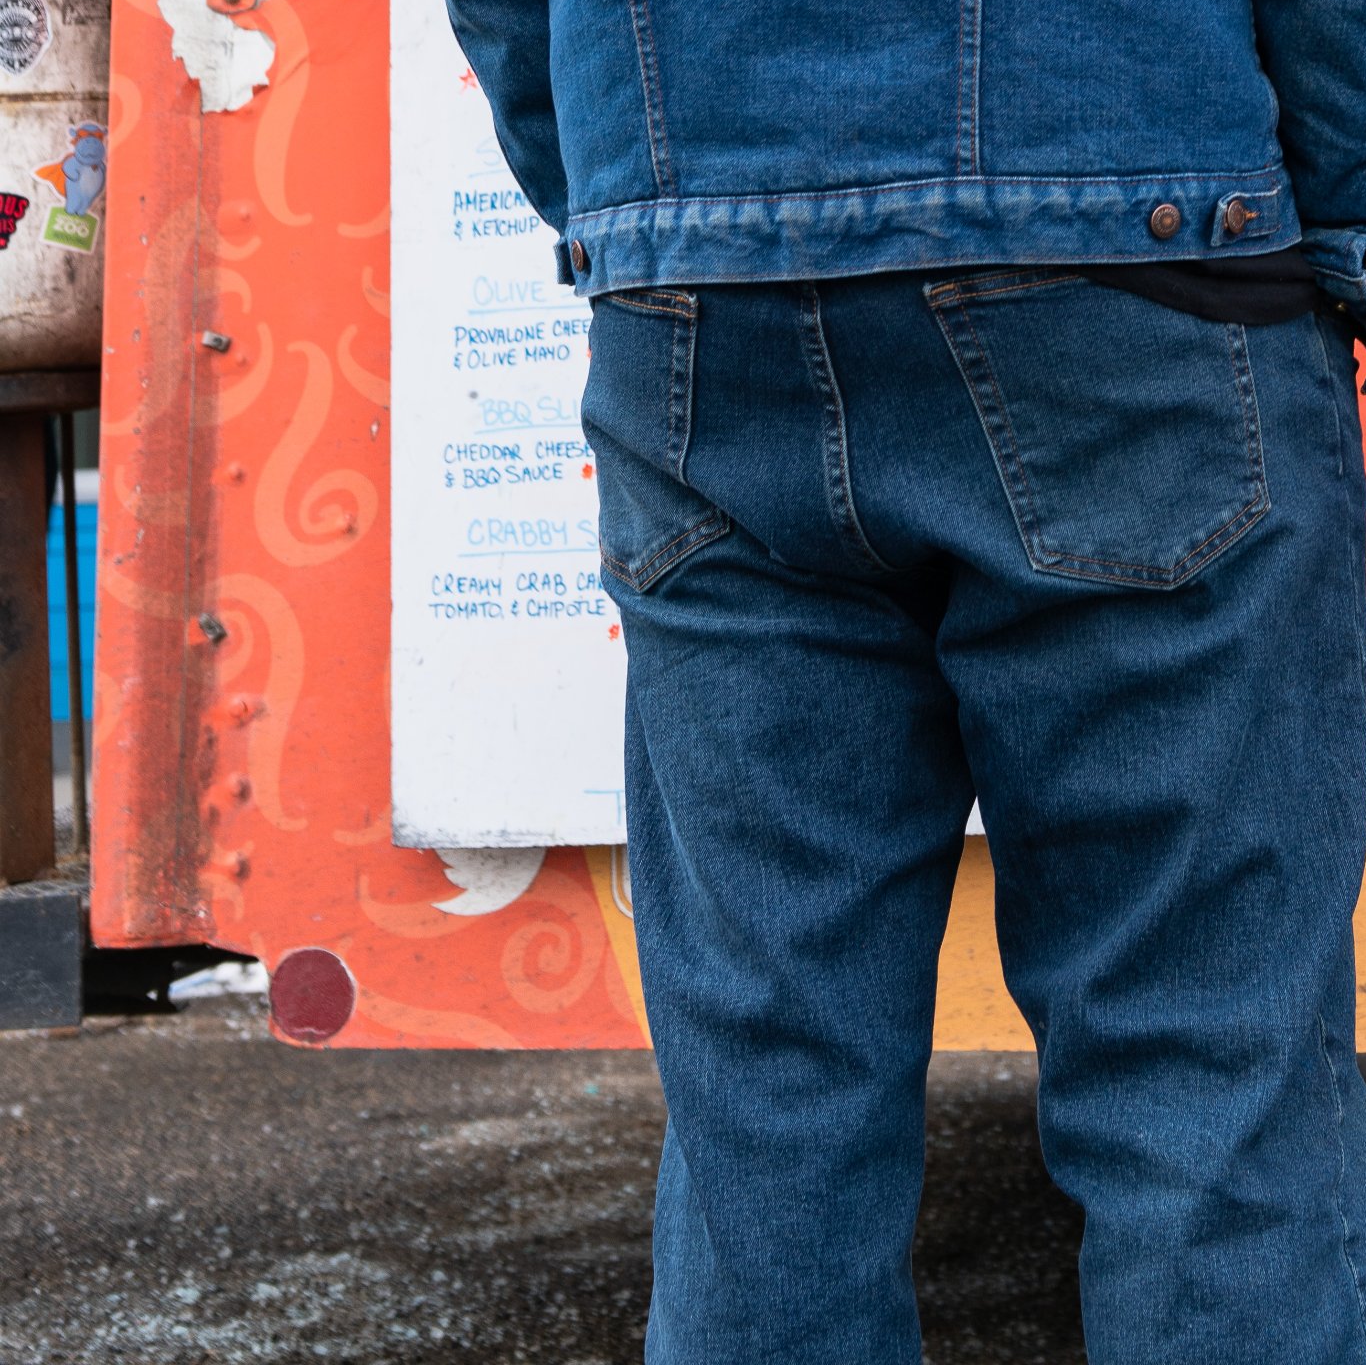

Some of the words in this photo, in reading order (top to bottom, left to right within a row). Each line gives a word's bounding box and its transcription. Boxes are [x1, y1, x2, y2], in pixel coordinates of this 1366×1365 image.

[472, 216, 540, 237] KETCHUP
[473, 276, 547, 305] OLIVE
[454, 322, 545, 347] PROVALONE
[552, 319, 590, 337] CHEE
[467, 349, 517, 369] OLIVE
[525, 344, 570, 362] MAYO
[478, 398, 534, 427] BBQ
[444, 443, 523, 464] CHEDDAR
[463, 467, 502, 489] BBQ
[505, 463, 563, 484] SAUCE
[467, 518, 568, 547] CRABBY
[431, 573, 502, 596] CREAMY
[516, 572, 567, 595] CRAB
[526, 599, 606, 619] CHIPOTLE
